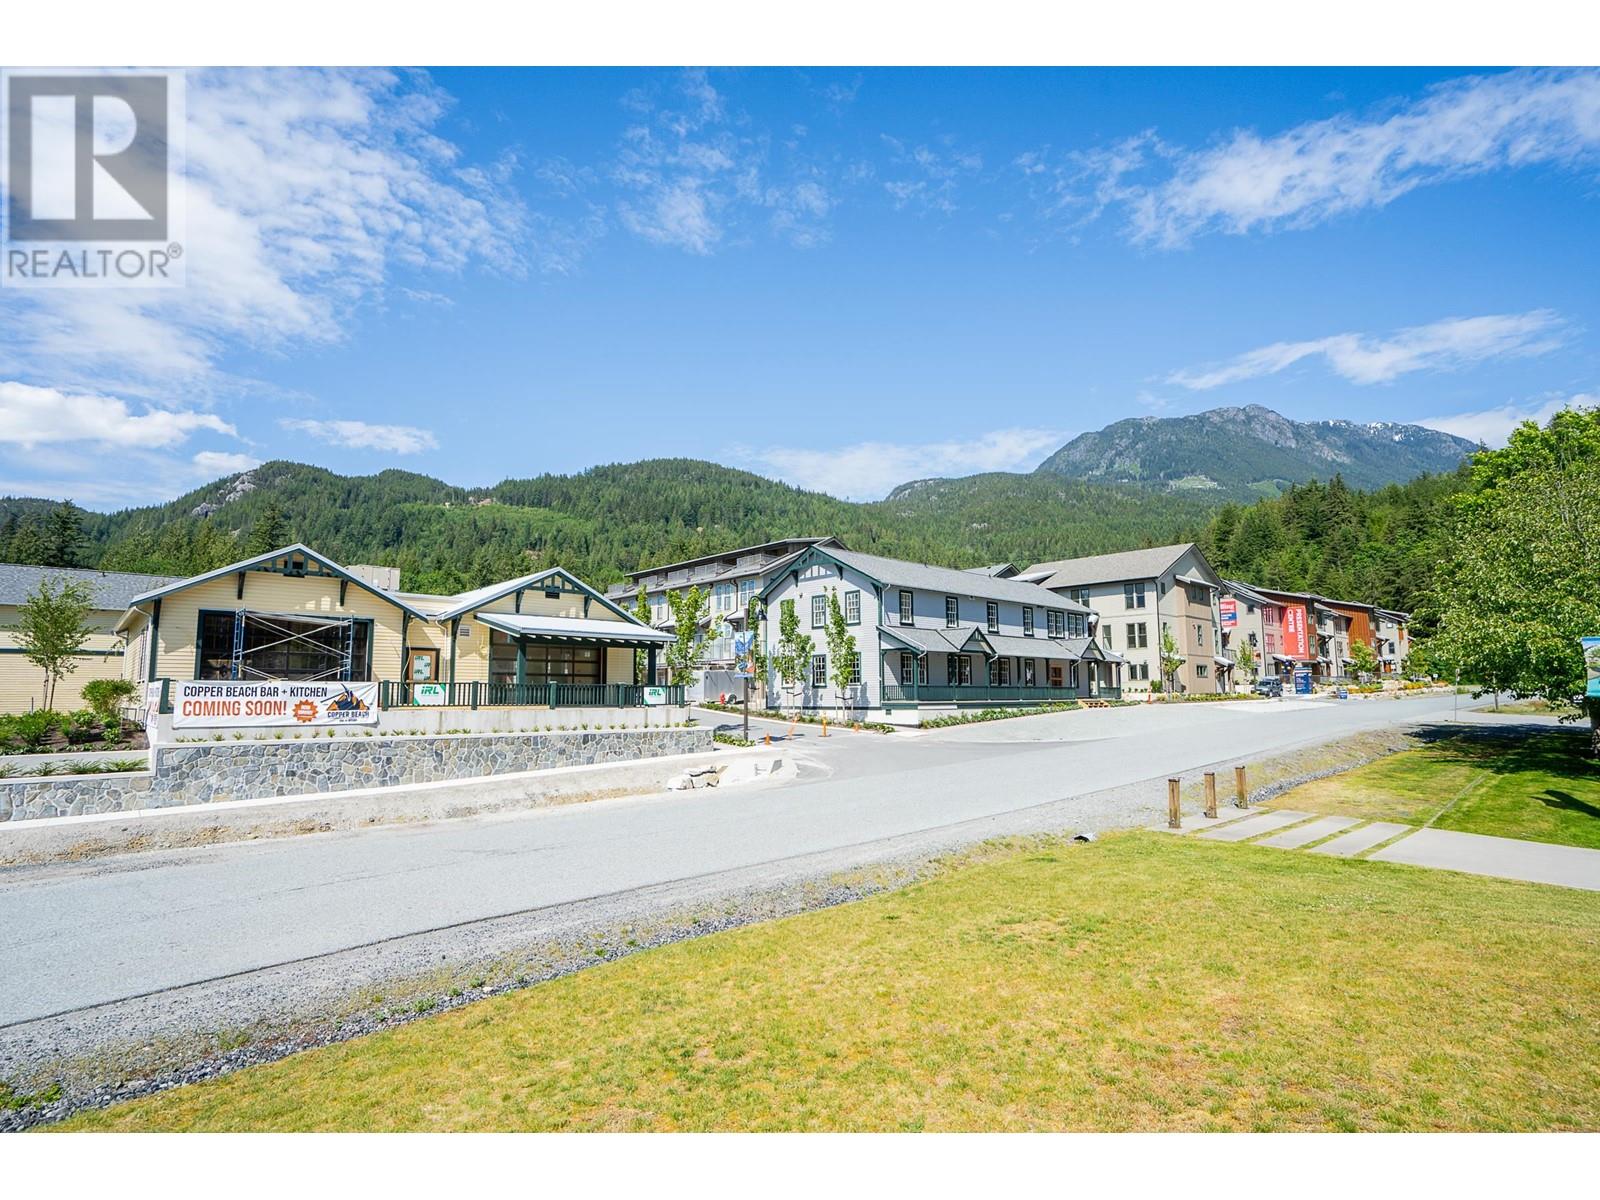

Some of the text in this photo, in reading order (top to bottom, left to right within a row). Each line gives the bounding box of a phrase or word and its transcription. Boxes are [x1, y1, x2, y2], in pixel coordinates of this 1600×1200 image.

[184, 686, 223, 697] COPPER
[225, 686, 258, 697] BEACH
[260, 686, 279, 697] BAR
[290, 687, 328, 697] KITCHEN
[182, 700, 241, 716] COMING
[245, 700, 288, 716] SOON!
